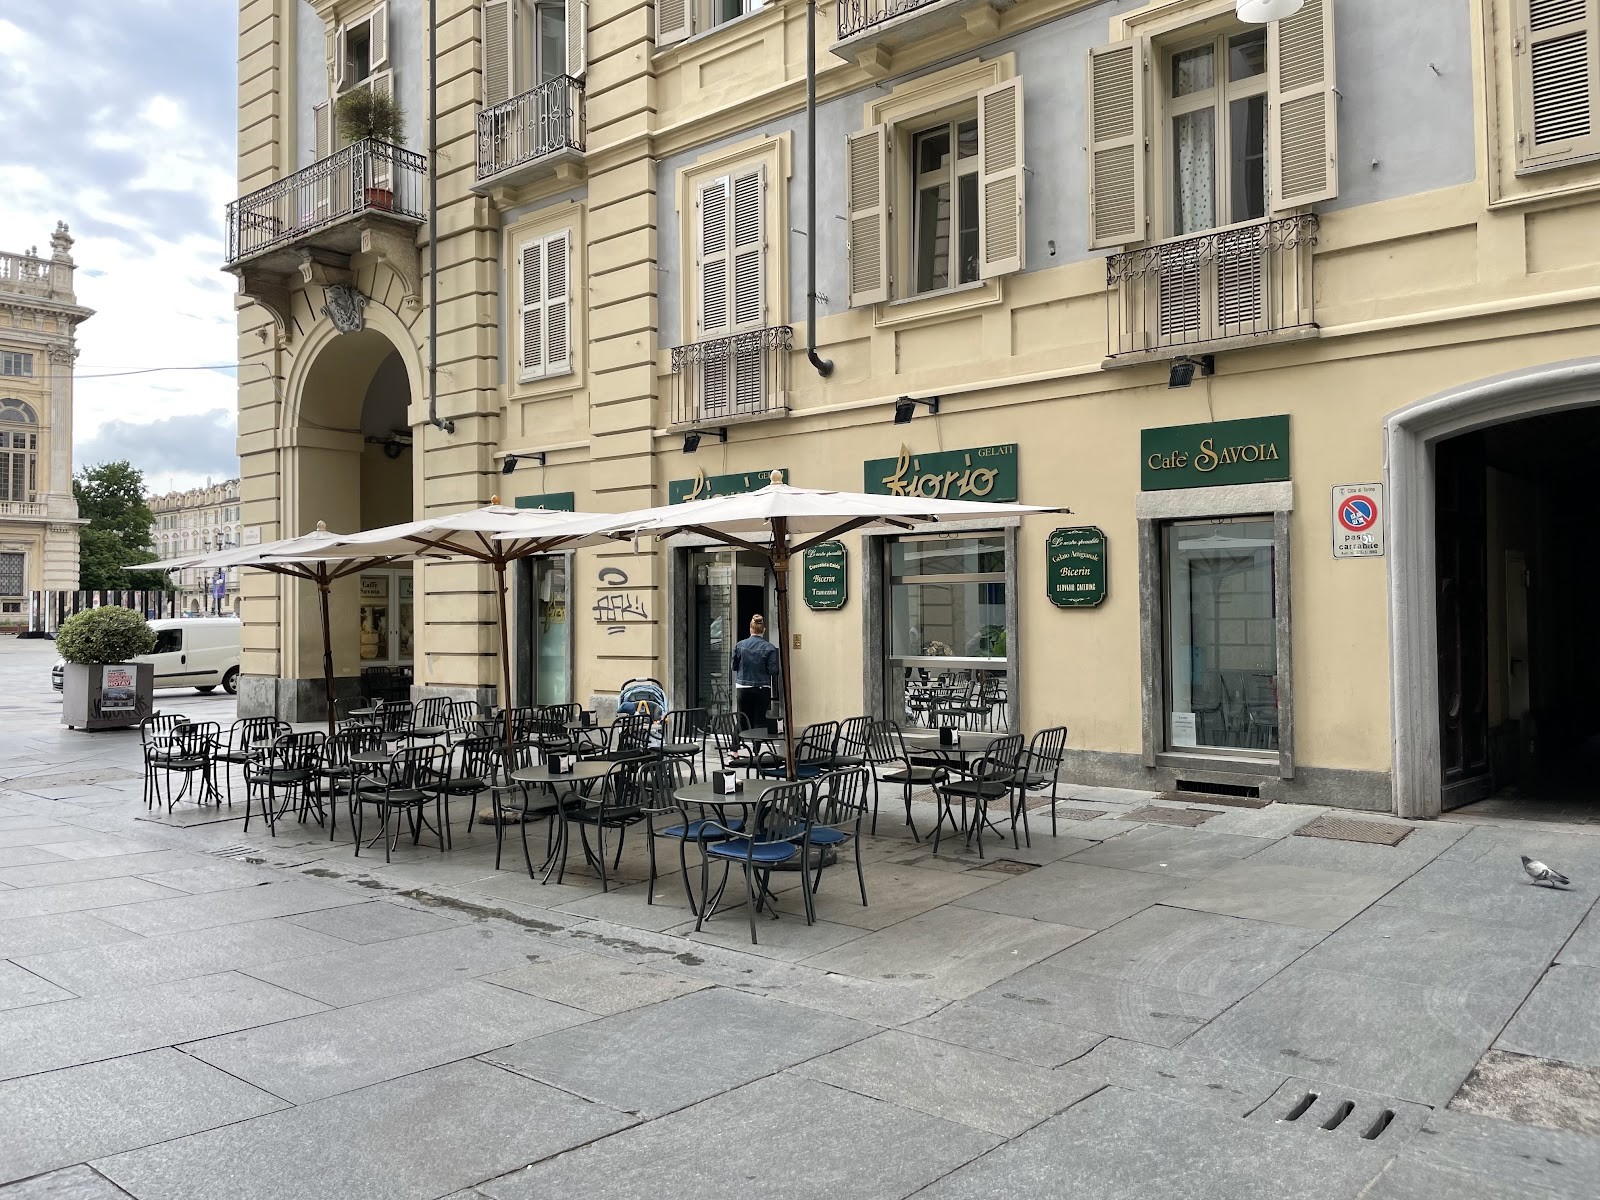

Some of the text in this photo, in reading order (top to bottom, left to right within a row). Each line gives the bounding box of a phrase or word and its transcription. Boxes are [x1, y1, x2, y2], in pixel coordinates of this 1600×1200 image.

[977, 445, 1014, 457] GELATI
[1194, 438, 1280, 472] SAVOIA
[1060, 566, 1091, 577] Bicerin
[813, 574, 835, 583] Bicerin
